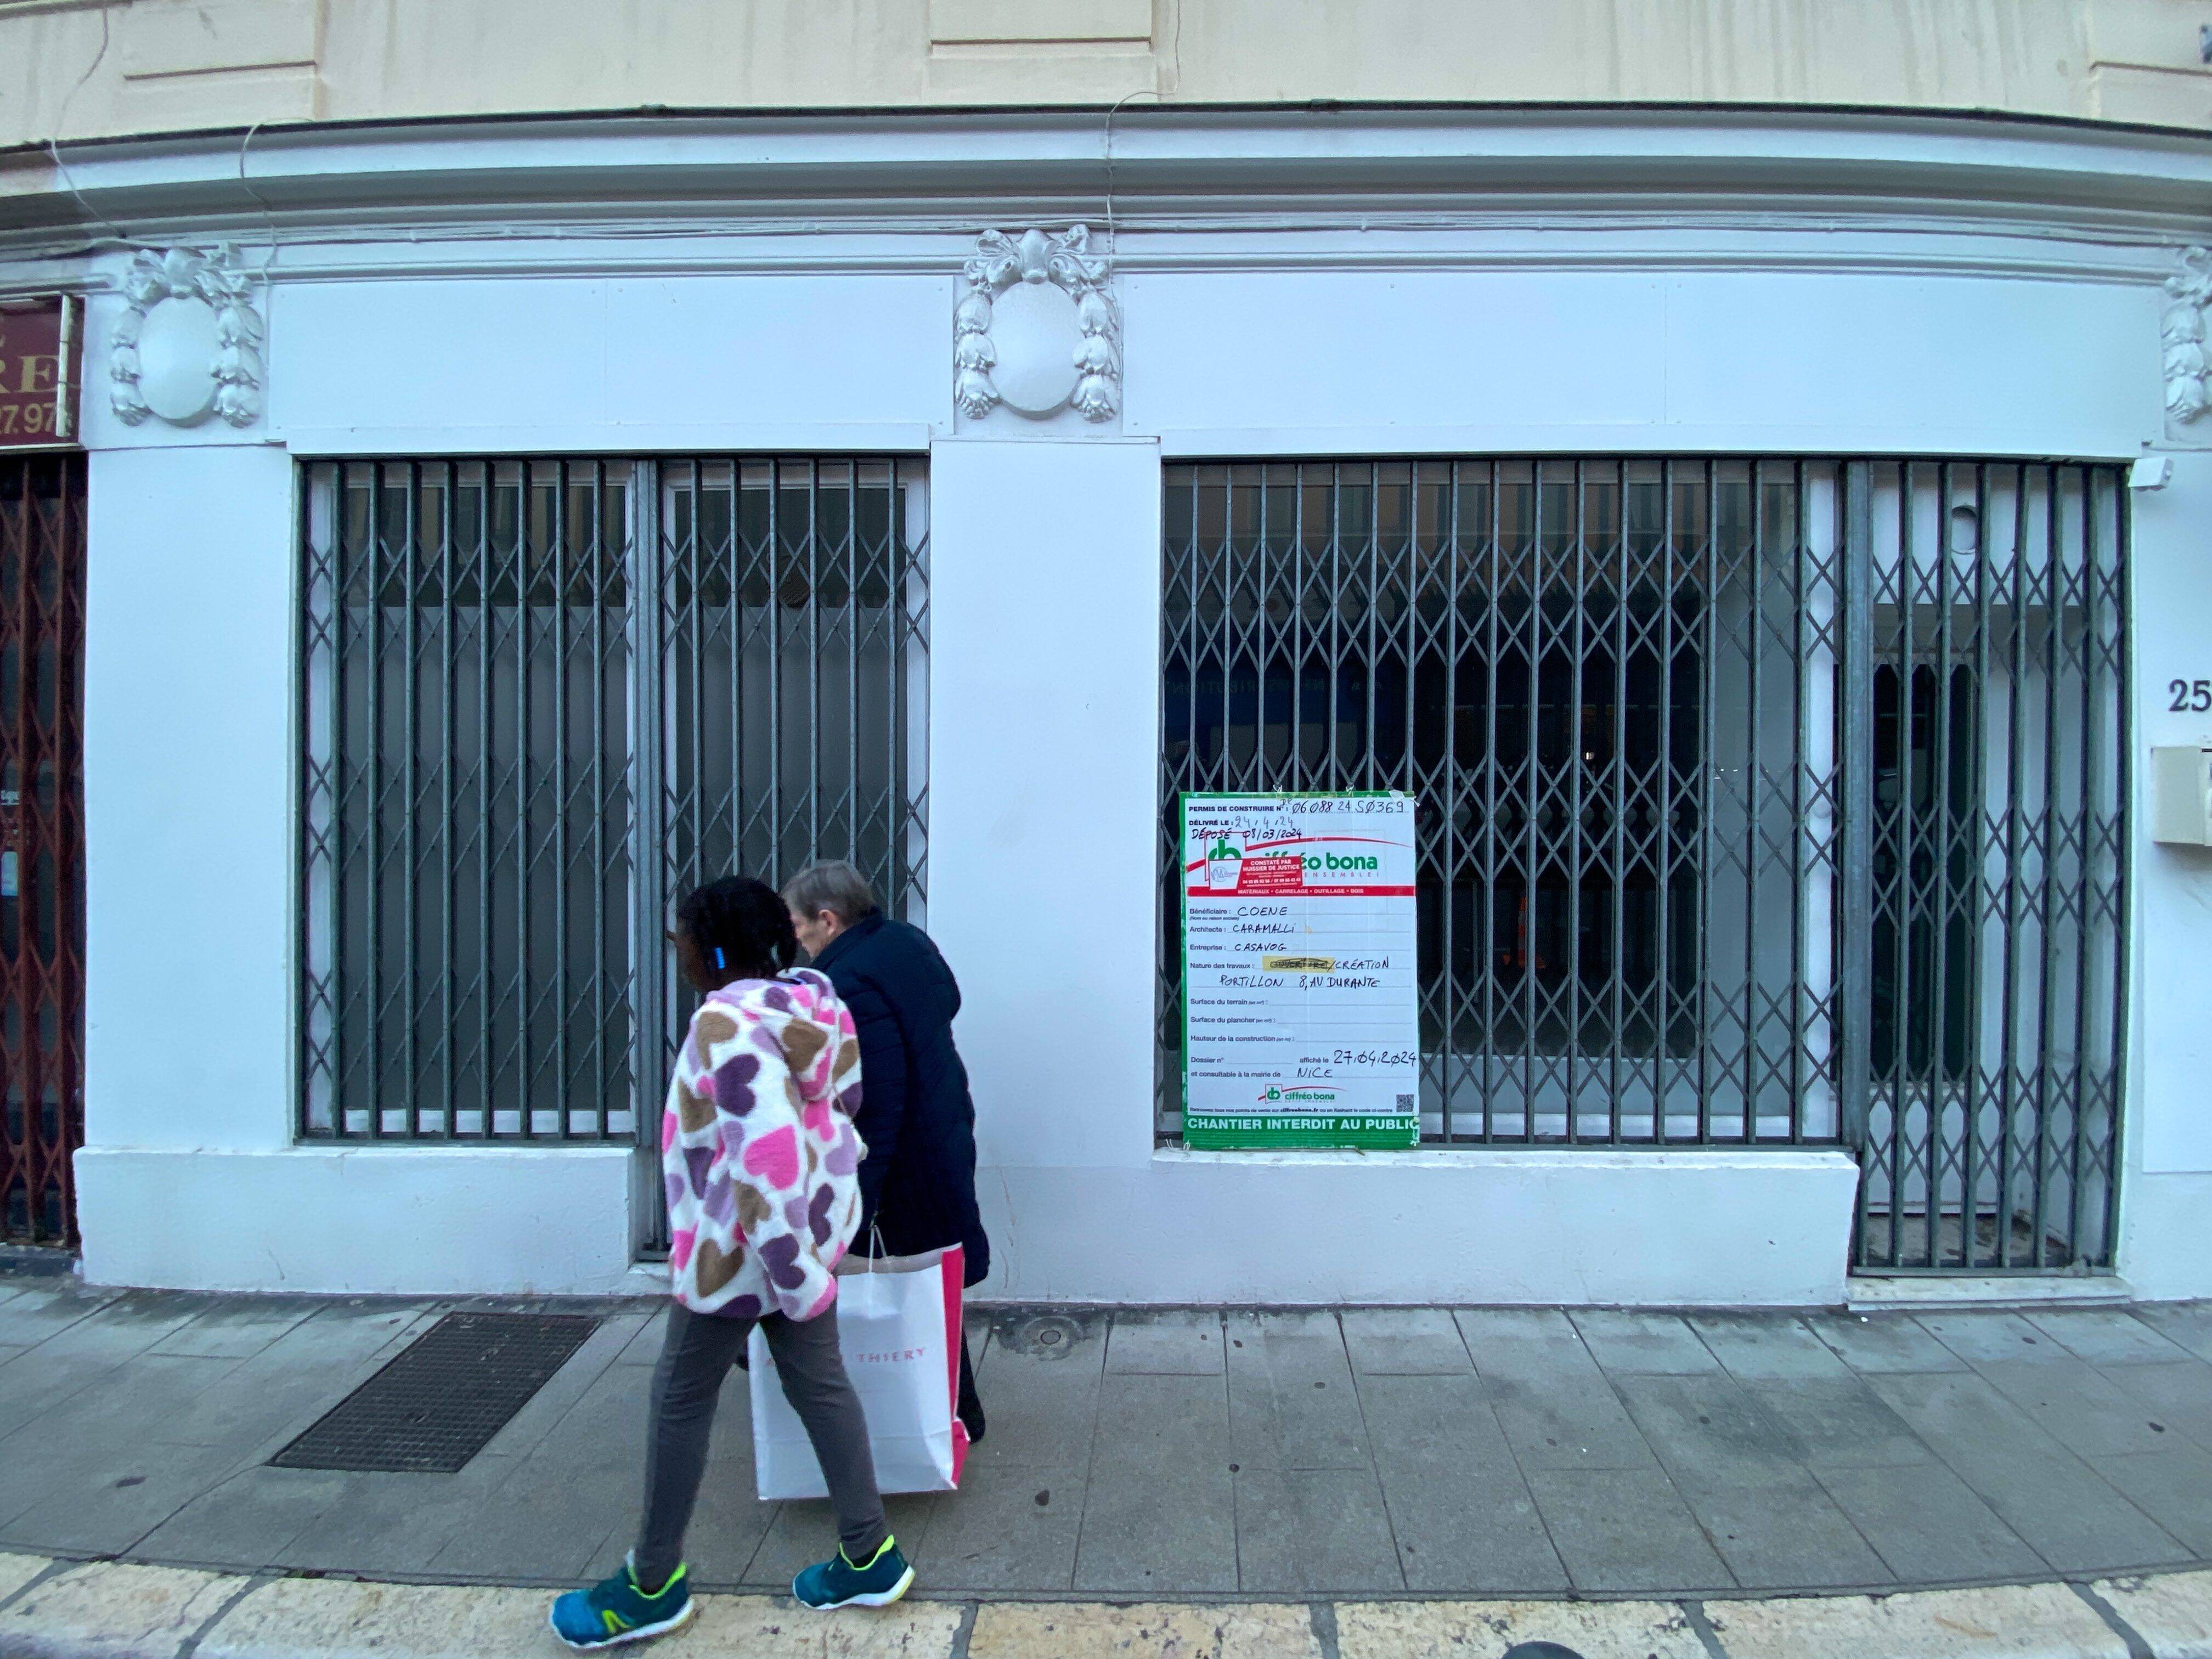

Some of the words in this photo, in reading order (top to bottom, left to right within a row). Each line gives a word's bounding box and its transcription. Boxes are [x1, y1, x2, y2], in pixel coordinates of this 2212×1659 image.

[2168, 679, 2212, 712] 25
[1338, 801, 1351, 812] 24
[1326, 852, 1378, 870] bona
[1237, 906, 1288, 916] COENE
[1310, 976, 1323, 988] AV
[1327, 976, 1380, 989] DURANTE
[1297, 1067, 1333, 1078] NICE
[1285, 1092, 1312, 1100] ciffréo
[1313, 1092, 1335, 1100] bona
[1187, 1118, 1262, 1130] CHANTIER
[1267, 1118, 1335, 1130] INTERDIT
[1340, 1119, 1361, 1130] AU
[1365, 1118, 1420, 1130] PUBLIC
